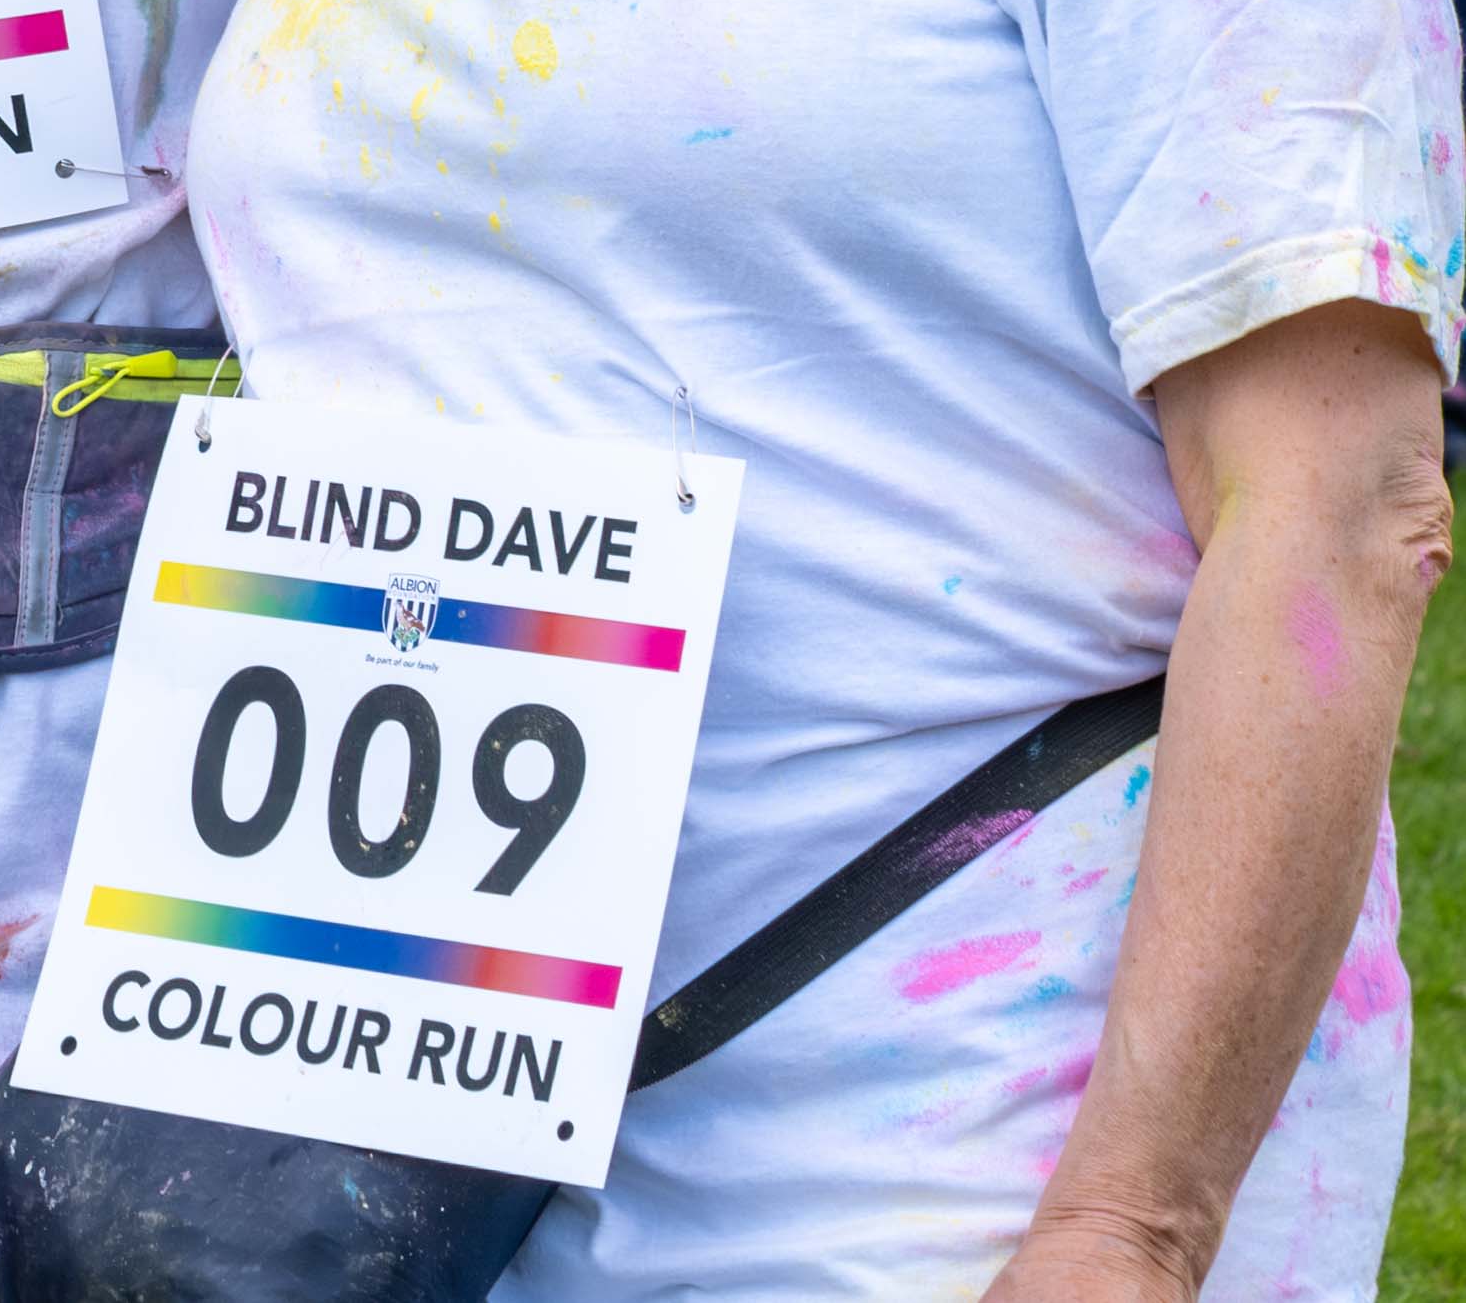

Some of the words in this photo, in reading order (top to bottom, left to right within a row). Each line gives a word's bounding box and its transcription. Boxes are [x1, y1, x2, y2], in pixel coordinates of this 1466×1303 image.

[226, 472, 421, 551] BLIND
[444, 498, 637, 583] DAVE
[391, 577, 437, 594] ALBION
[192, 666, 585, 895] 009
[103, 971, 390, 1074] COLOUR
[408, 1019, 562, 1102] RUN
